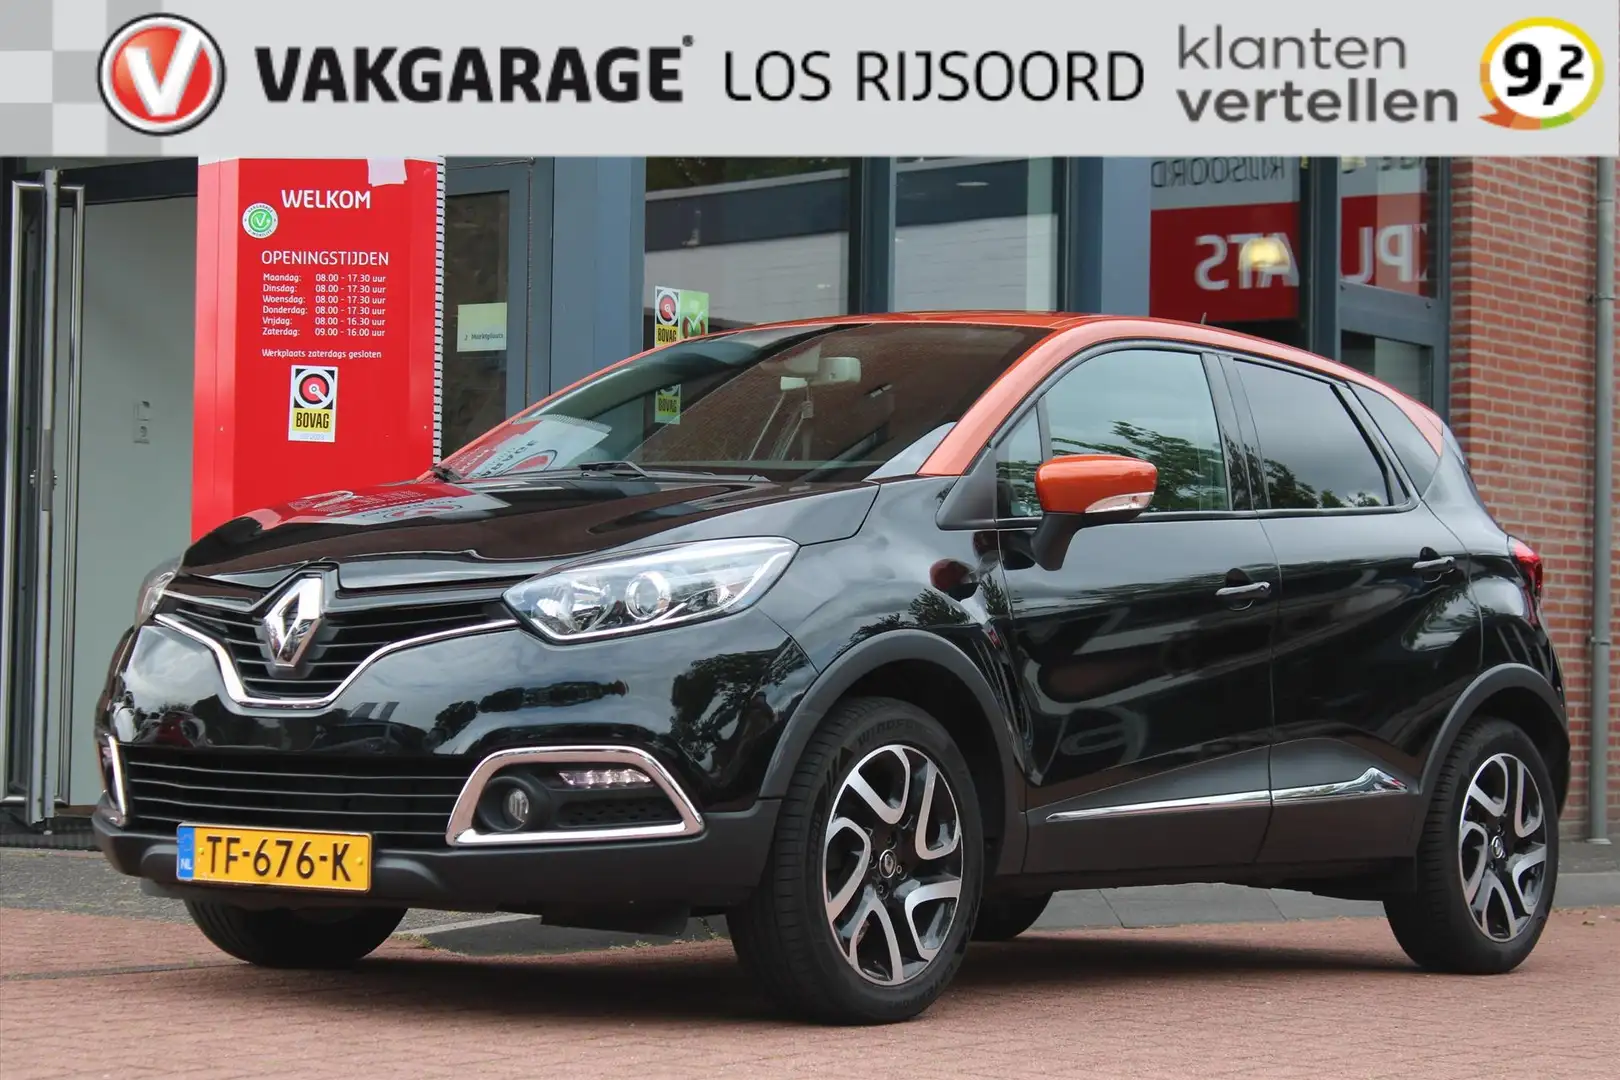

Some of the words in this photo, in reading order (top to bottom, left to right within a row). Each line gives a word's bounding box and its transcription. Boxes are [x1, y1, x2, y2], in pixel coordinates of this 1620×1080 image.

[281, 189, 371, 209] WELKOM
[261, 250, 389, 266] OPENINGSTIJDEN
[263, 273, 301, 283] Maandag:
[315, 274, 339, 282] 08.00
[347, 274, 370, 282] 17.30
[372, 275, 386, 283] uur
[263, 284, 297, 294] Dinsdag:
[315, 285, 339, 293] 08.00
[347, 285, 370, 293] 17.30
[372, 286, 386, 294] uur
[262, 295, 306, 304] Woensdag:
[315, 296, 339, 304] 08.00
[347, 296, 370, 304] 17.30
[372, 297, 386, 305] uur
[262, 306, 308, 315] Donderdag:
[315, 306, 339, 314] 08.00
[347, 306, 370, 314] 17.30
[372, 307, 386, 315] uur
[262, 317, 292, 326] Vrijdag:
[315, 317, 339, 325] 08.00
[347, 317, 370, 325] 16.30
[372, 318, 386, 326] uur
[262, 327, 300, 337] Zaterdag:
[315, 328, 339, 336] 09.00
[347, 328, 370, 336] 16.00
[372, 329, 386, 337] uur
[657, 327, 677, 343] BOVAG
[262, 349, 306, 360] Werkplaats
[308, 350, 346, 360] zaterdags
[348, 350, 382, 360] gesloten
[296, 412, 330, 429] BOVAG
[180, 858, 192, 870] NL
[206, 835, 351, 882] TF-676-K
